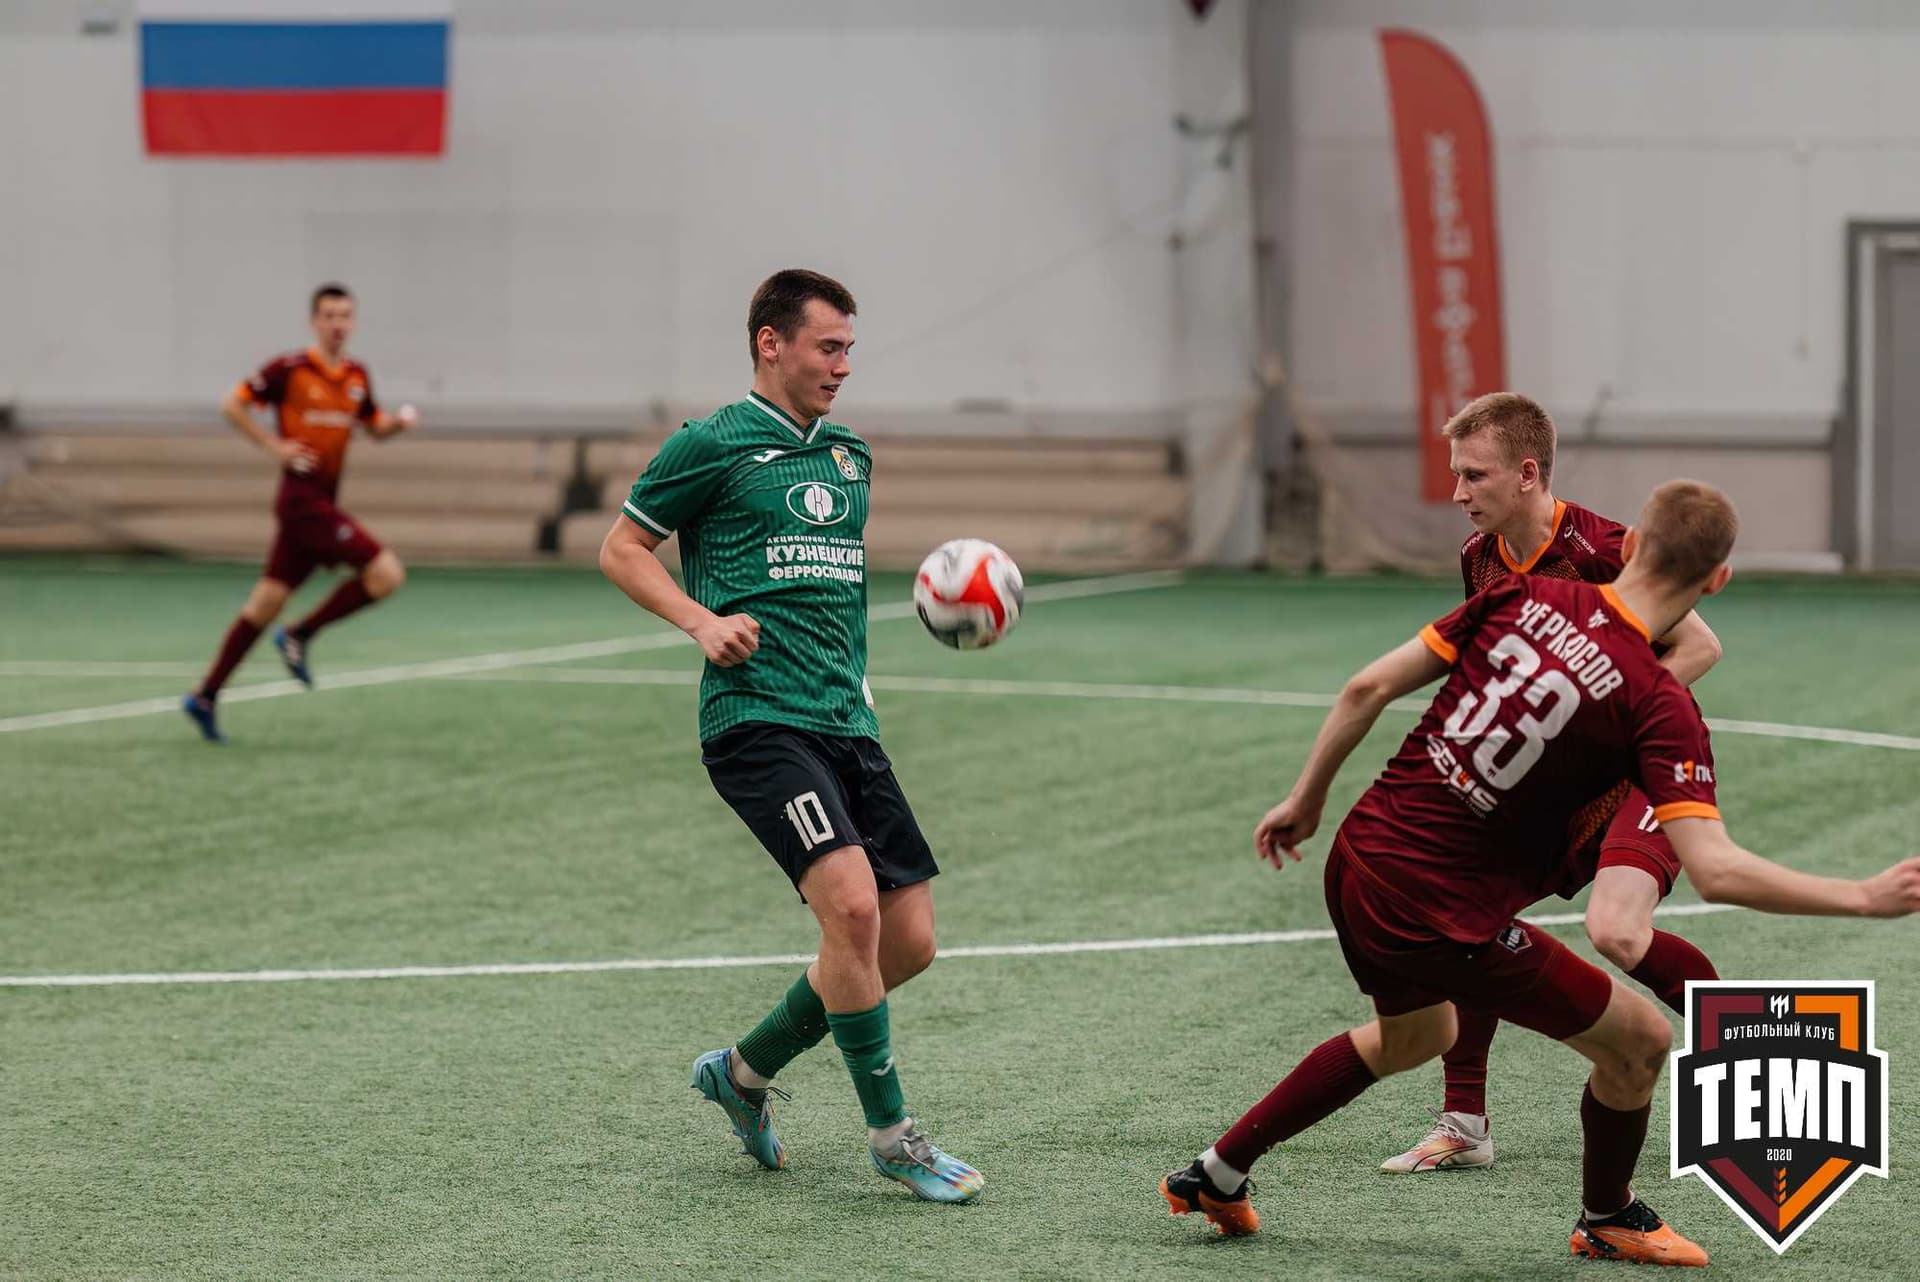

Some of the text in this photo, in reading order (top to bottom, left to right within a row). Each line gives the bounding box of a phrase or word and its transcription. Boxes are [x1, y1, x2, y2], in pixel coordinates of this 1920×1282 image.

[766, 544, 863, 566] КУЗНЕЦКИЕ
[767, 536, 826, 545] АКЦИОНЕРНОЕ
[768, 565, 863, 583] ФЕРРОСПЛАВЫ
[1514, 599, 1624, 700] ЧЕРКАСОВ
[1444, 633, 1581, 791] 33
[785, 791, 835, 851] 10
